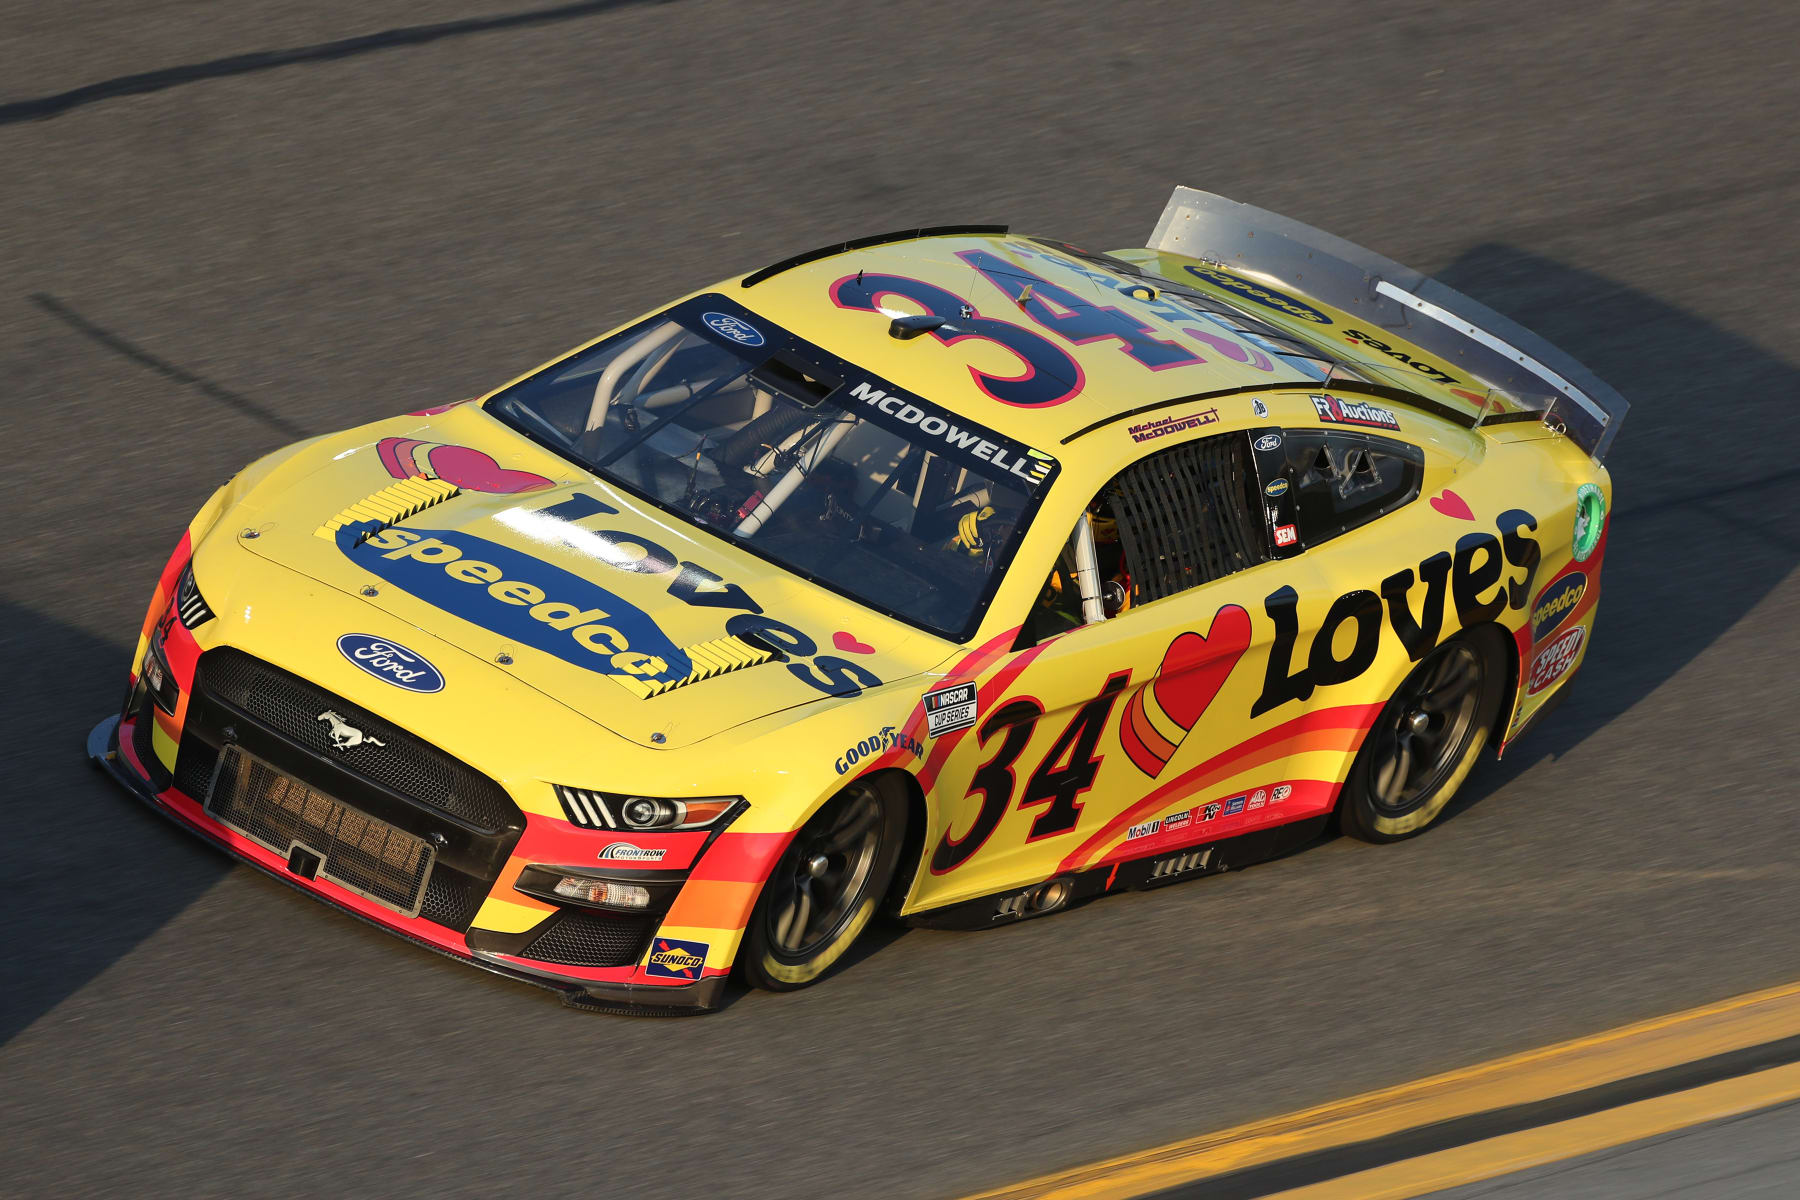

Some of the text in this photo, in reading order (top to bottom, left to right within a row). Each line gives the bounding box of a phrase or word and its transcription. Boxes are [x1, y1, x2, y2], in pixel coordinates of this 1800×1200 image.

[711, 317, 749, 343] Ford
[828, 249, 1208, 408] 34
[849, 381, 1042, 480] MCDOWELL
[1261, 436, 1278, 450] Ford
[1267, 482, 1288, 494] speedco
[1276, 526, 1296, 545] SEM
[372, 526, 667, 692] speedco
[1534, 584, 1583, 627] speedco
[355, 641, 426, 684] Ford
[1536, 629, 1583, 675] SPEEDY
[1534, 652, 1575, 689] CASH
[940, 687, 969, 706] NASCAR
[934, 706, 970, 727] CUP SERIES
[930, 667, 1132, 877] 34
[1127, 822, 1151, 840] Mobil
[1165, 812, 1189, 825] LINCOLN
[653, 953, 703, 967] SUNOCO
